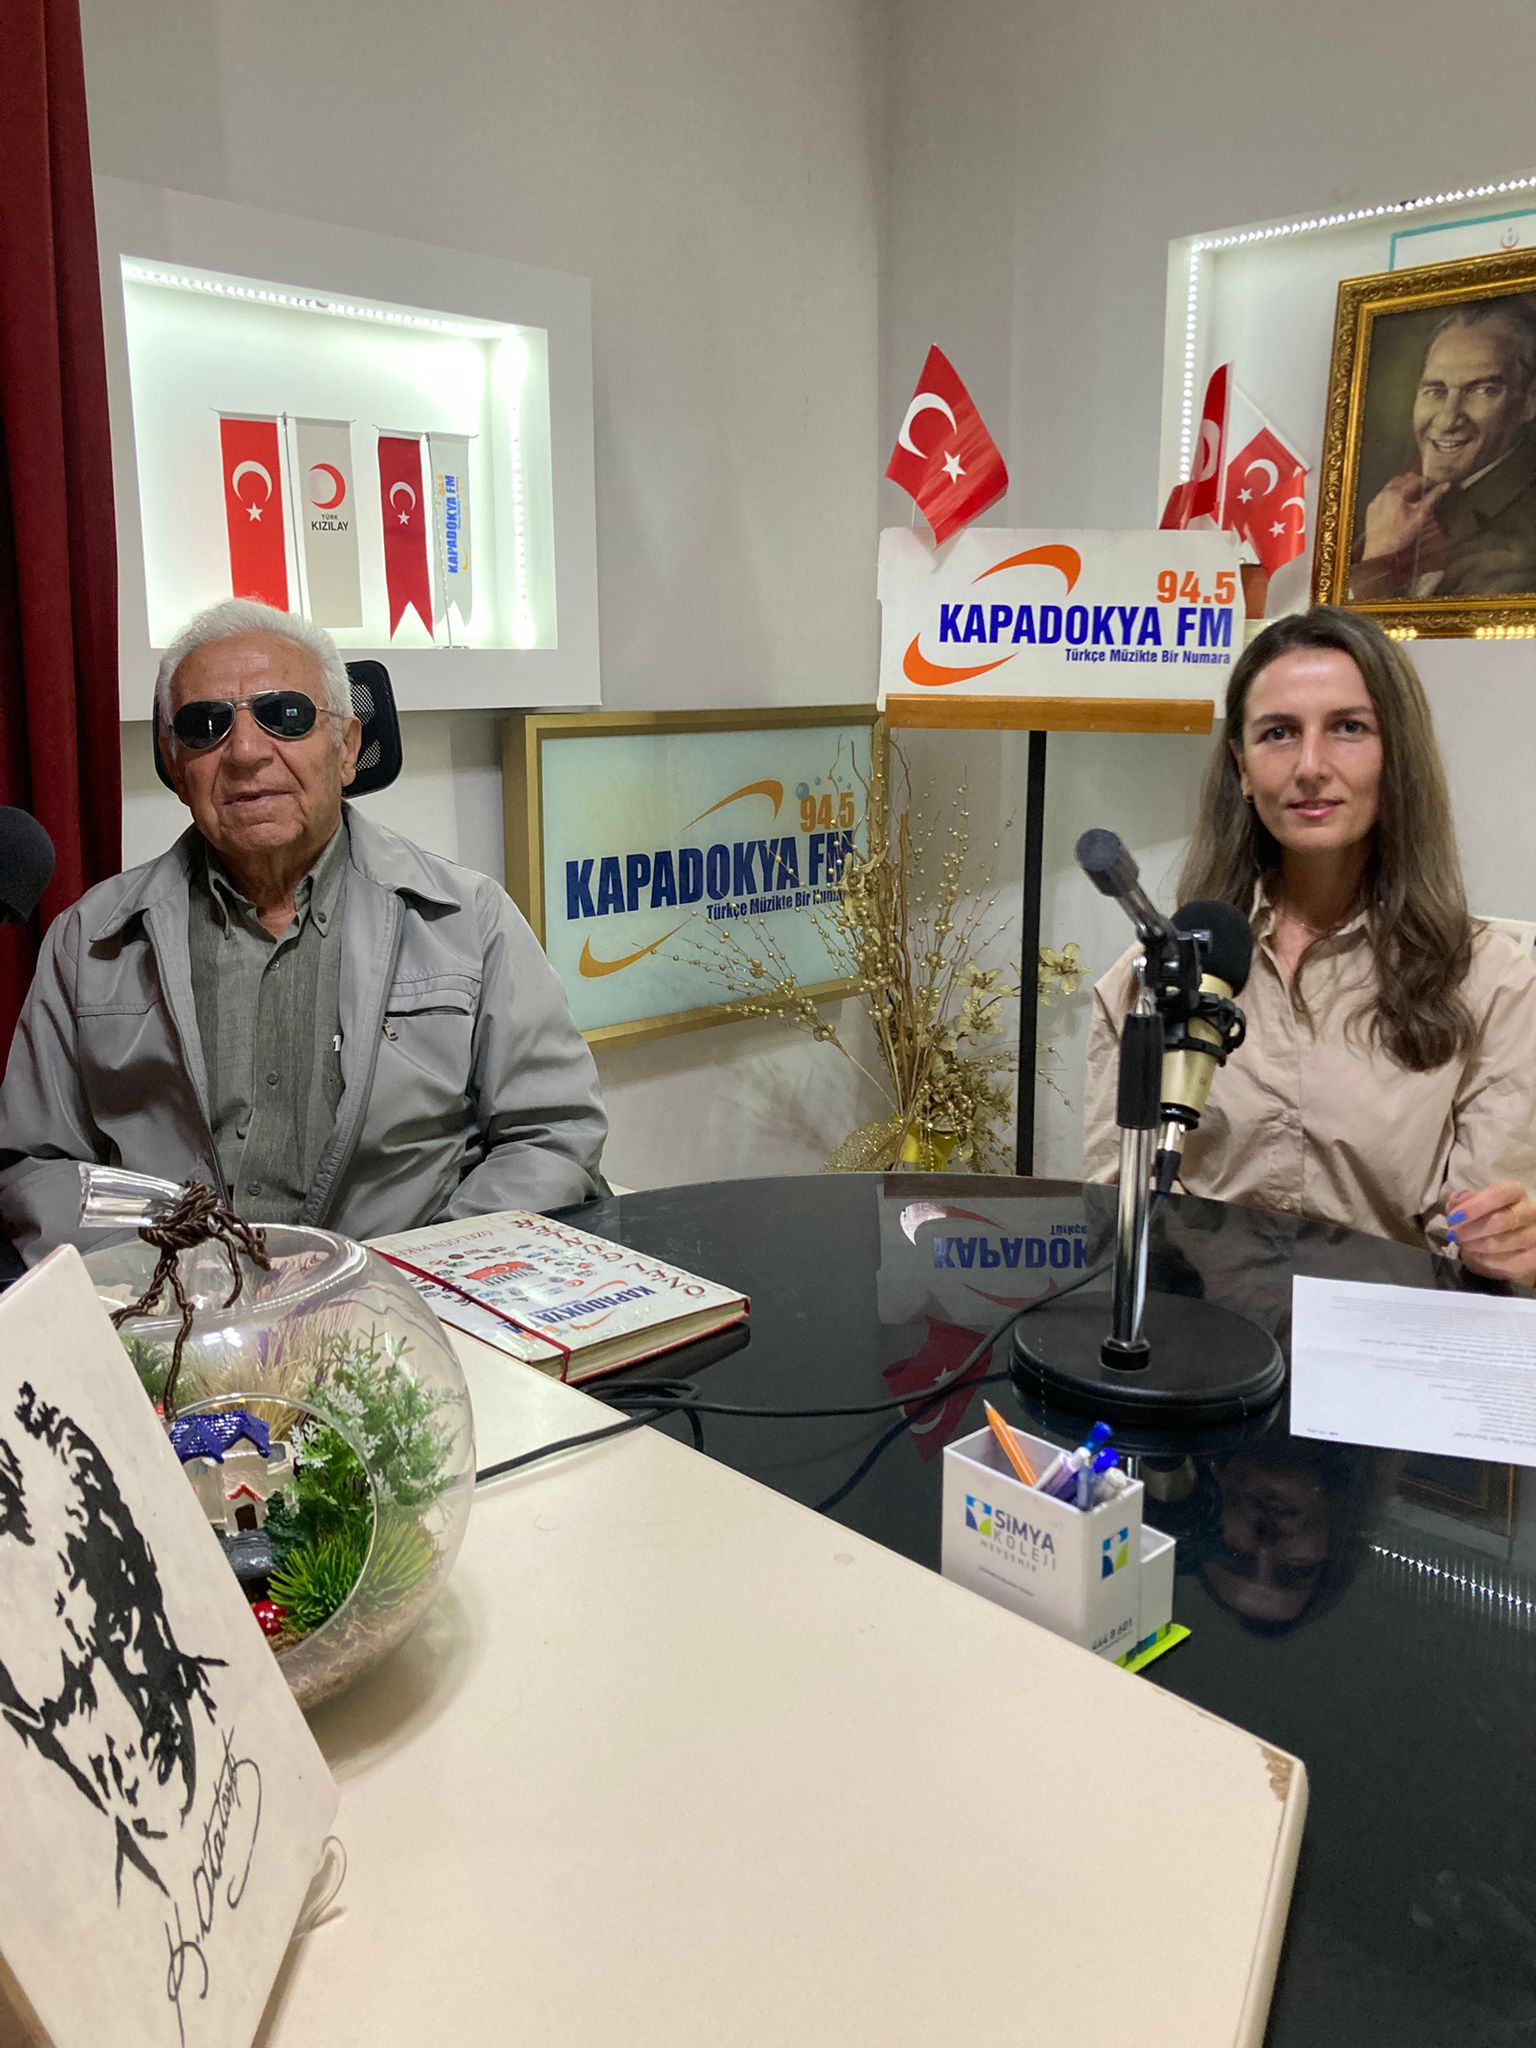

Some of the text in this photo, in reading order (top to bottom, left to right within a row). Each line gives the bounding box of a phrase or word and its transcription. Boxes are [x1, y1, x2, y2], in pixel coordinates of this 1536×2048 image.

[445, 474, 456, 494] FM
[311, 521, 348, 531] KIZILAY
[321, 512, 338, 520] TÜRK
[446, 497, 459, 574] KAPADOKYA
[1157, 569, 1236, 605] 94.5
[939, 603, 1233, 648] KAPADOKYA FM
[1065, 648, 1231, 664] Türkçe Müzikte Bir Numara
[566, 836, 800, 920] KAPADOKYA
[706, 902, 748, 920] Türkçe
[750, 894, 793, 915] Müzikte
[795, 890, 811, 907] Bir
[536, 1285, 657, 1324] KAPADOKYA
